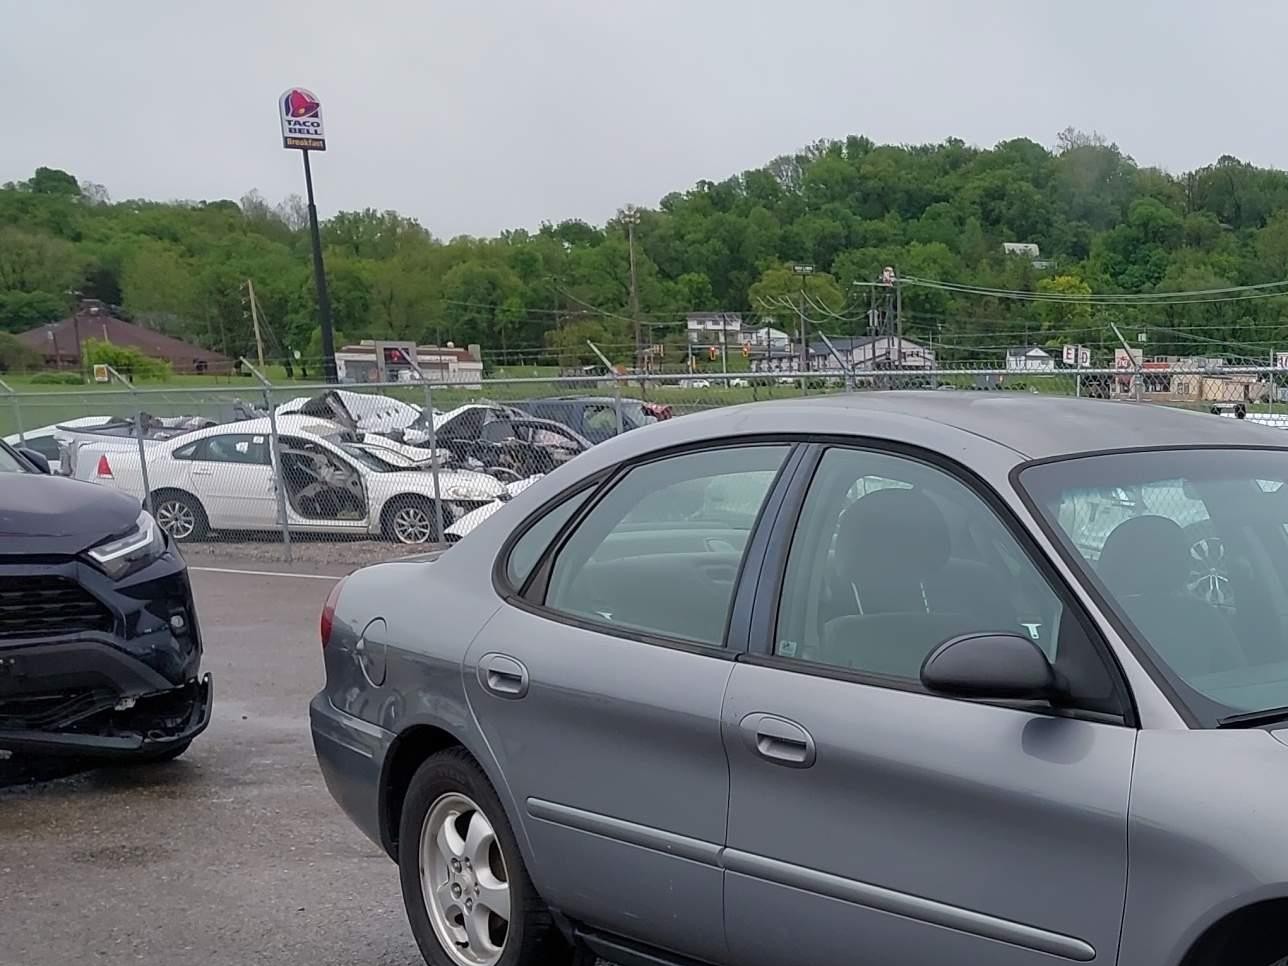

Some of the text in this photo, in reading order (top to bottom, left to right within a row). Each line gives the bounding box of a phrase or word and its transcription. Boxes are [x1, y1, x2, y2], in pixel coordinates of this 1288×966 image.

[285, 119, 321, 127] TACO
[1065, 345, 1073, 361] E
[1081, 351, 1088, 364] D
